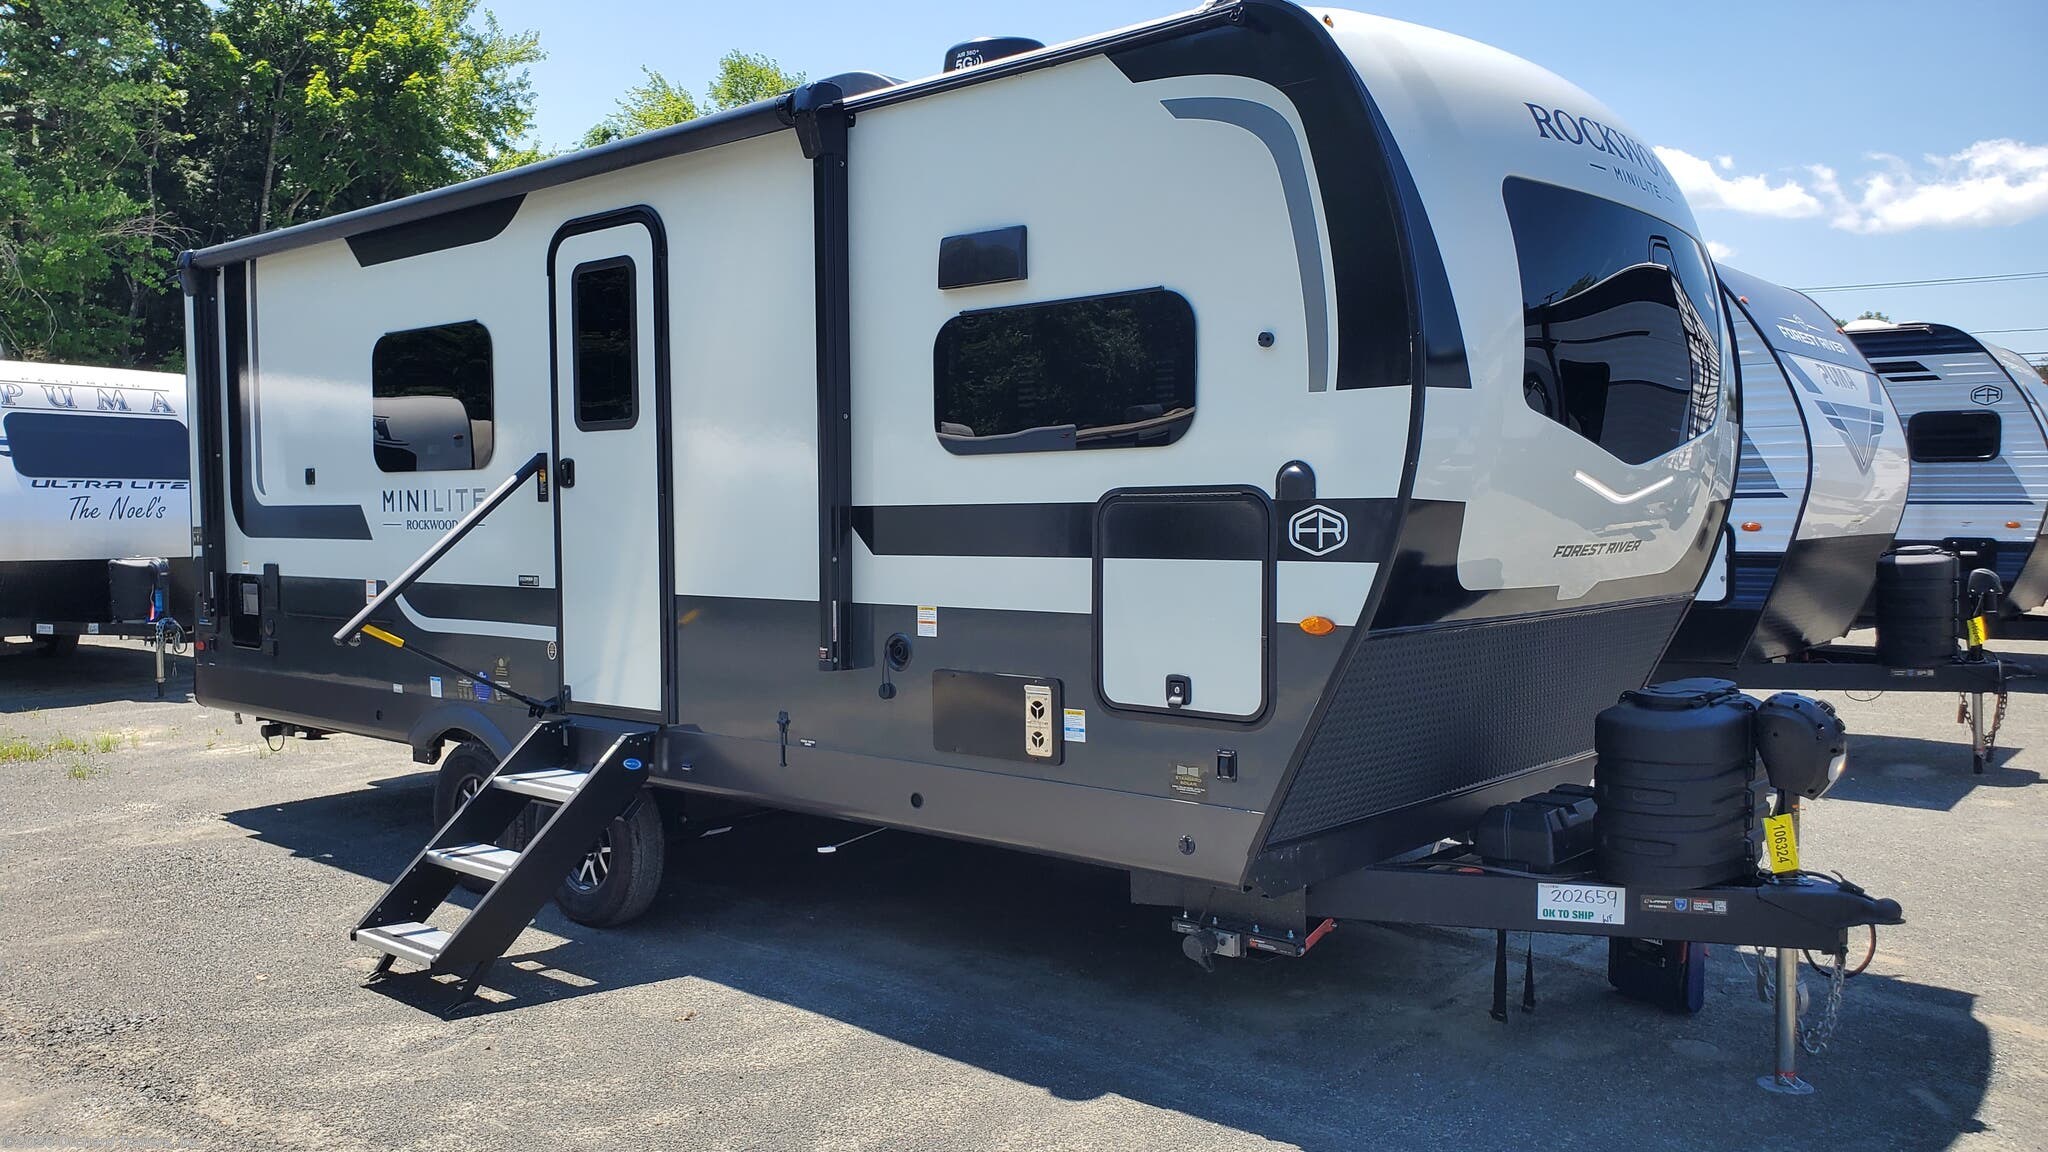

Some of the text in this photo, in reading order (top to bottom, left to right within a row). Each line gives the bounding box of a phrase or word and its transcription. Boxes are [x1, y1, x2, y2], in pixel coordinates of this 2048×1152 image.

[1613, 166, 1662, 199] MINILITE
[1776, 325, 1848, 355] FOREST RIVER
[1815, 363, 1858, 390] PUMA
[0, 383, 175, 413] PUMA
[31, 479, 189, 490] ULTRA LITE
[69, 495, 166, 520] The Noel's
[382, 488, 486, 512] MINILITE
[1553, 540, 1642, 558] FOREST RIVER
[1773, 824, 1791, 864] 106324
[1551, 889, 1618, 908] 202659
[1542, 908, 1595, 920] OK TO SHIP
